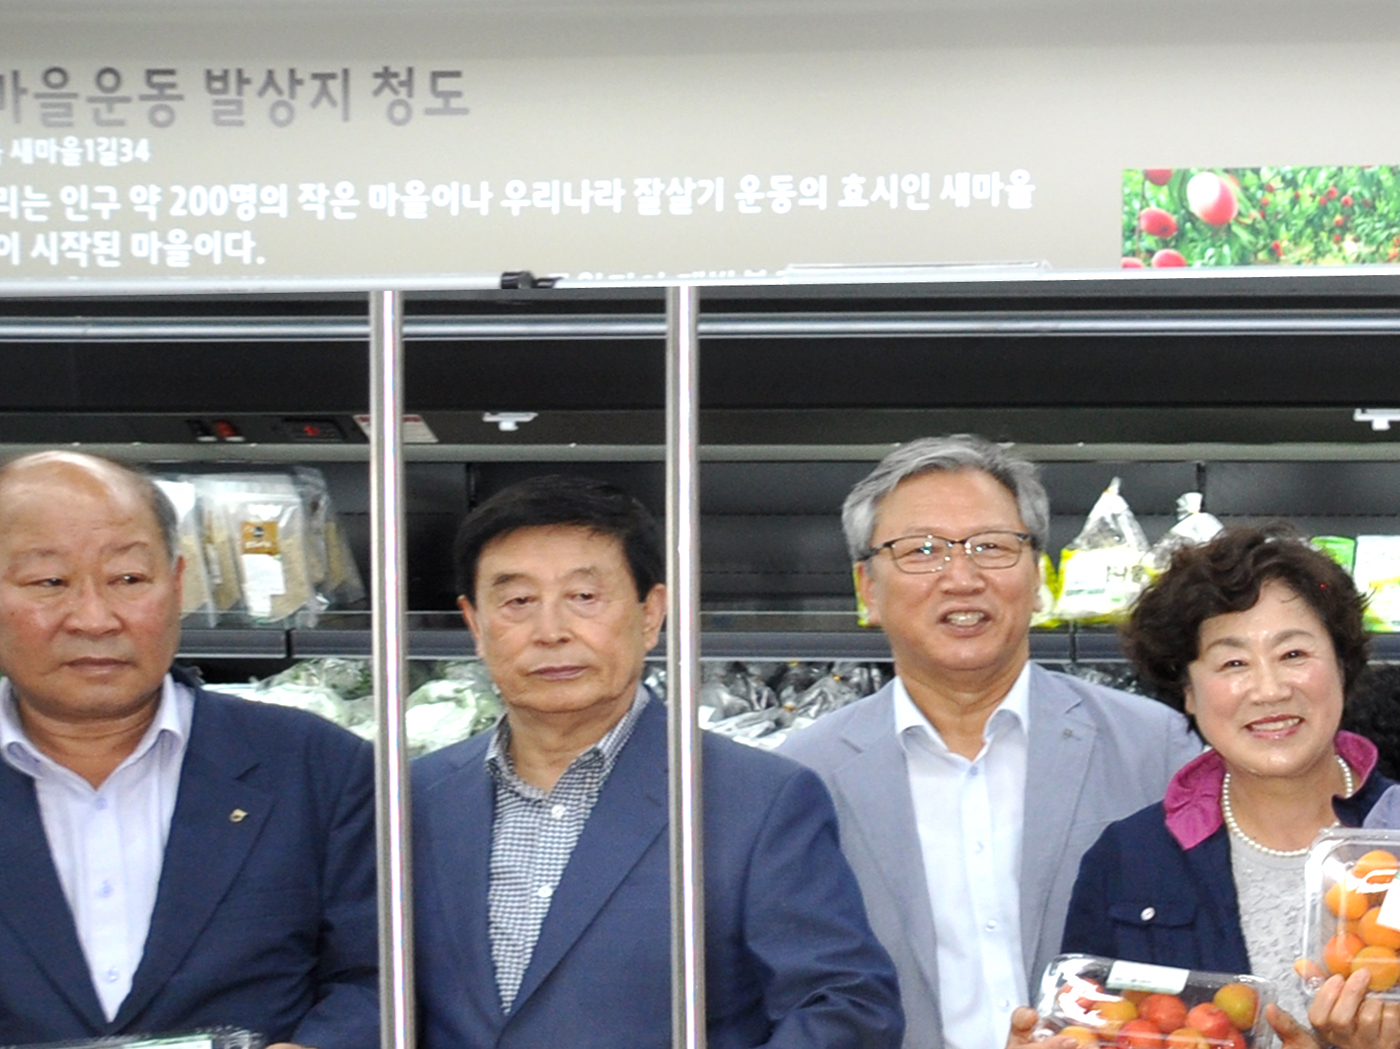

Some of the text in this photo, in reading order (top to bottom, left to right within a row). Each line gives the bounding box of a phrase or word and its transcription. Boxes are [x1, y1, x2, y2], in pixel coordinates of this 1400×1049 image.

[204, 66, 352, 128] 발상지
[371, 65, 470, 128] 청도
[60, 185, 121, 221] 인구
[129, 184, 161, 221] 약
[170, 184, 287, 221] 200명의
[298, 181, 360, 220] 작은
[369, 180, 493, 218] 마을이나
[501, 178, 626, 216] 우리나라
[634, 177, 724, 215] 잘살기
[735, 175, 827, 213] 운동의
[838, 173, 930, 210] 효시인
[940, 169, 1035, 209] 새마을
[31, 231, 120, 267] 시작된
[131, 230, 264, 267] 마을이다.
